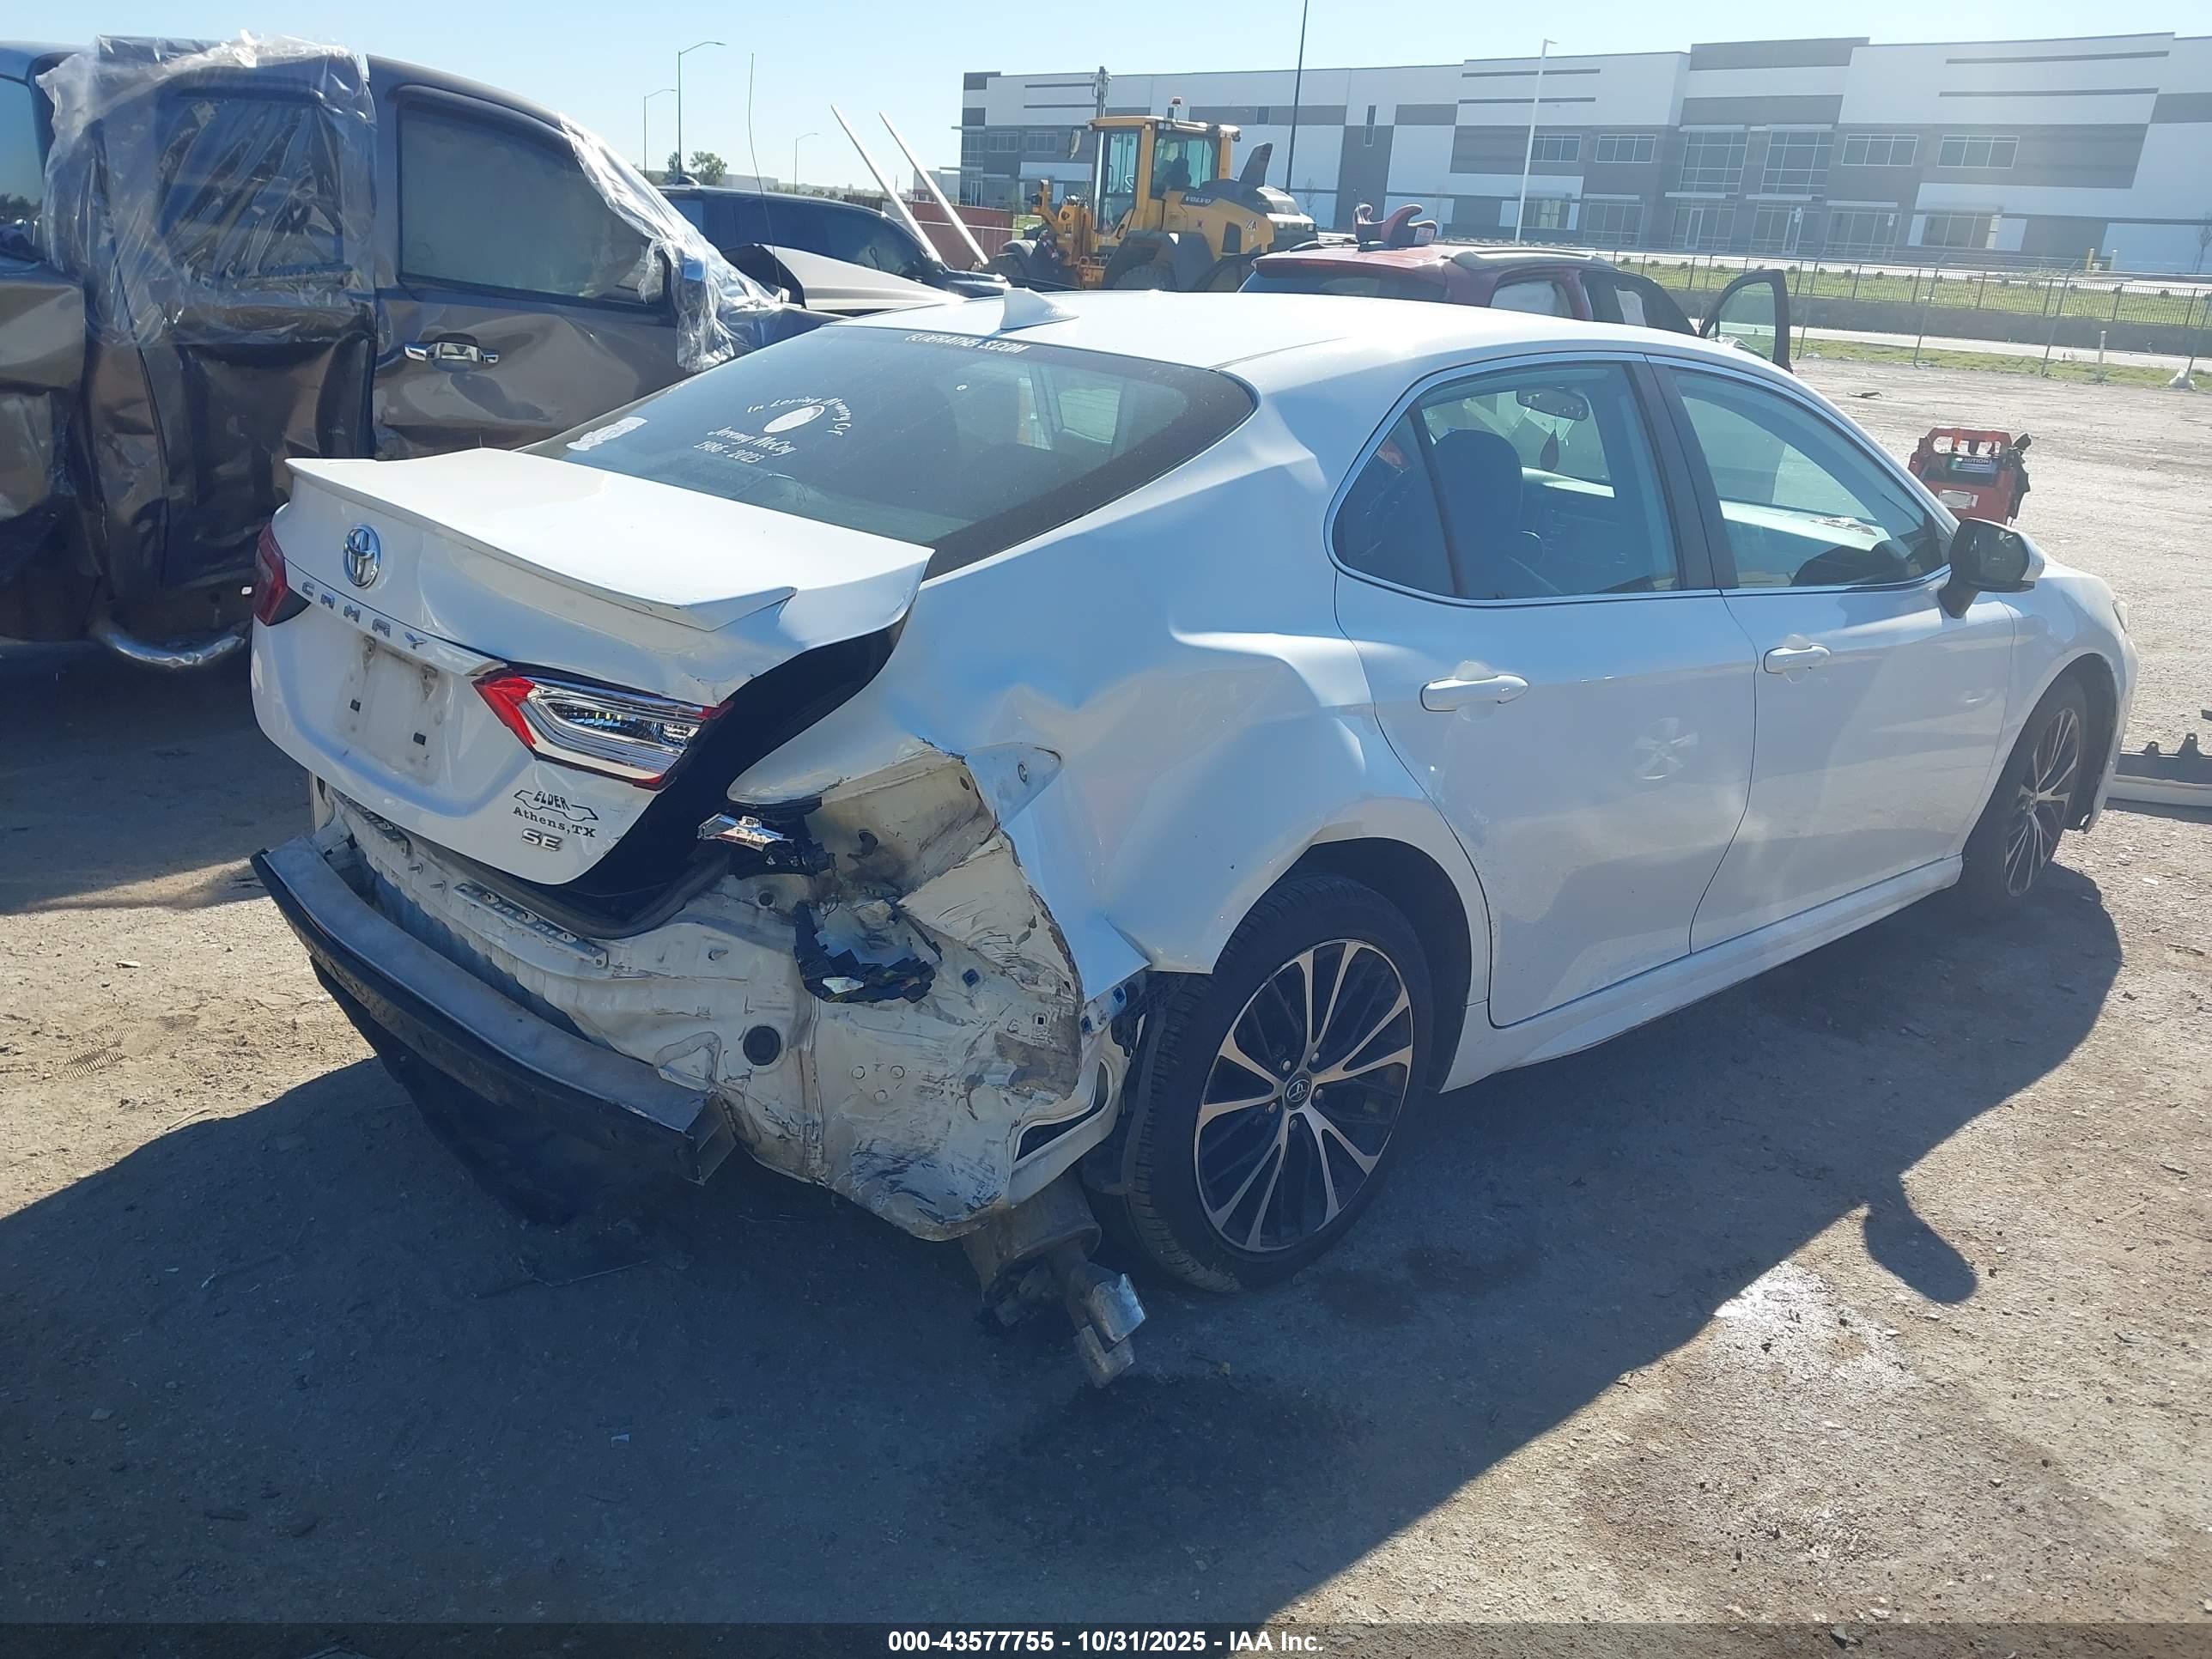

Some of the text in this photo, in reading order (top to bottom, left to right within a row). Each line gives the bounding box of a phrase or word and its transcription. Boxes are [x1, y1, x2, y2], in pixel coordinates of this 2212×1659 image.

[1185, 196, 1212, 205] VOLVO
[904, 332, 1030, 354] ELDERATHES.COM
[301, 581, 428, 650] CAMRY
[533, 790, 571, 811] ELDER
[521, 828, 563, 852] SE
